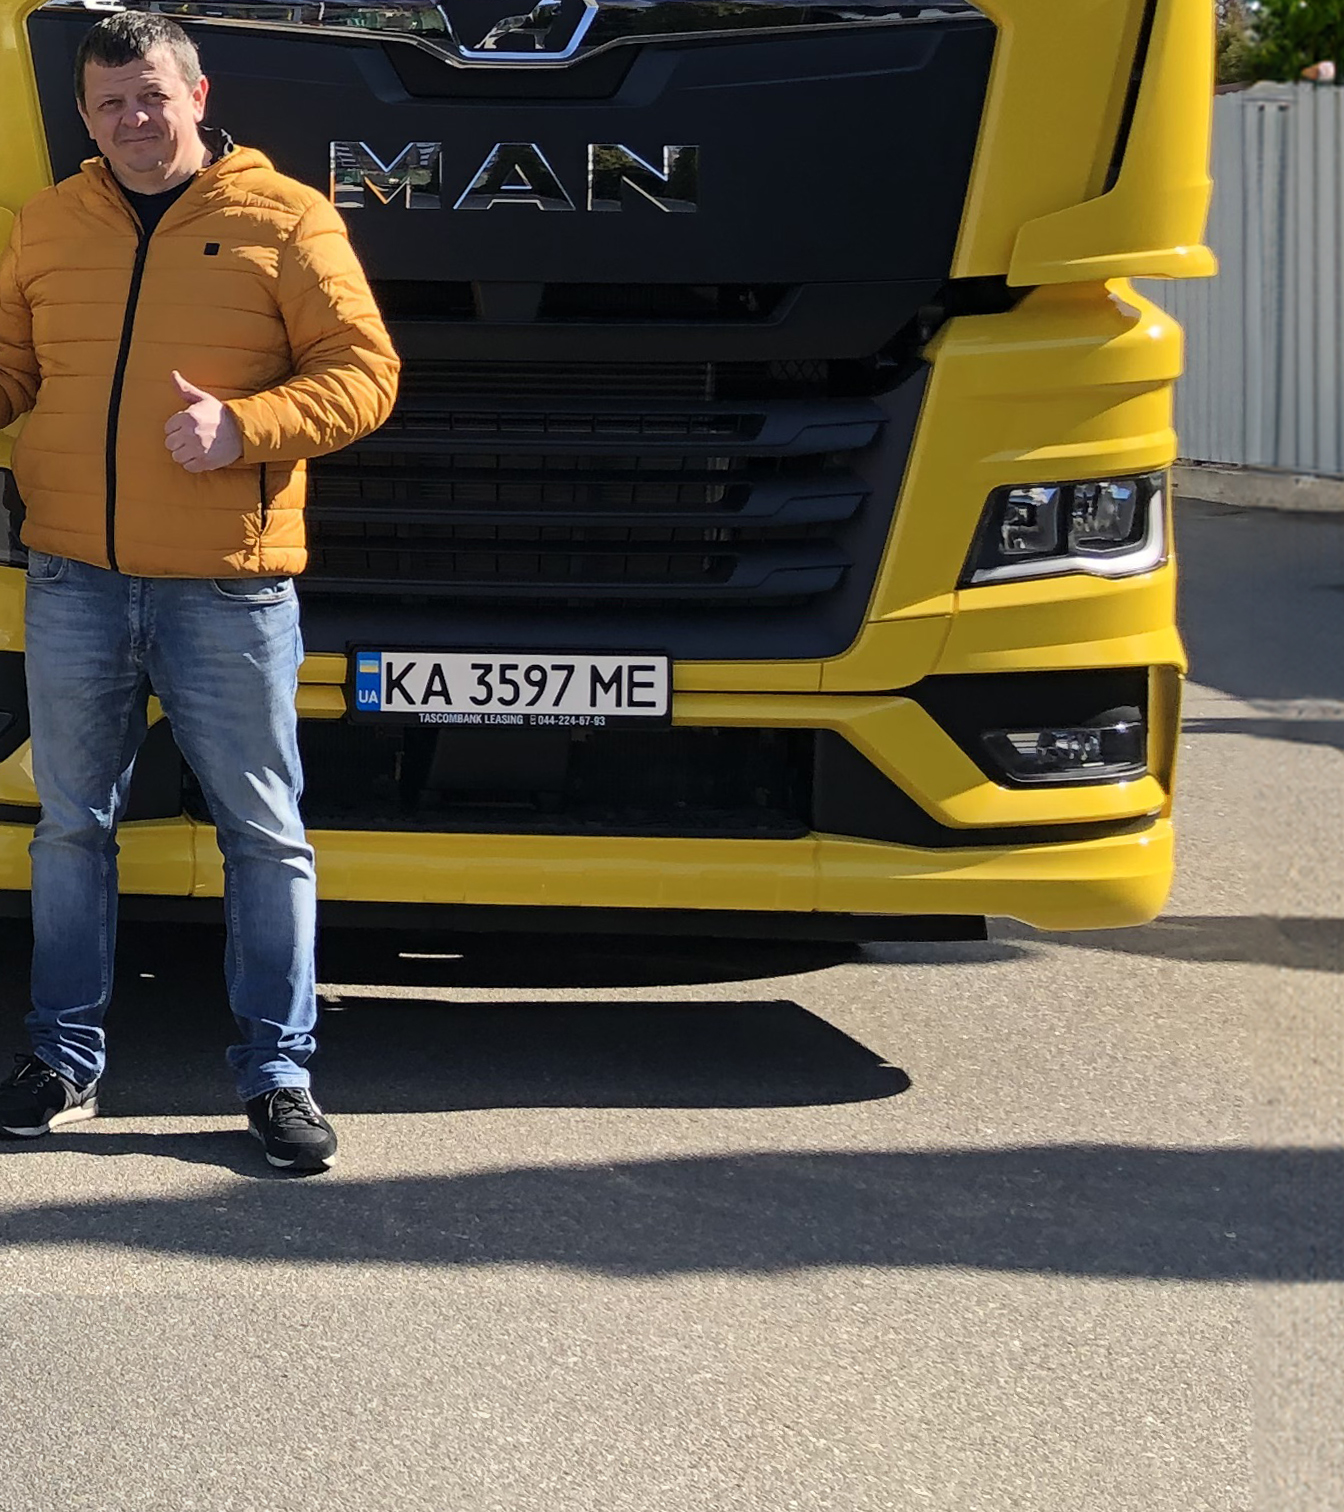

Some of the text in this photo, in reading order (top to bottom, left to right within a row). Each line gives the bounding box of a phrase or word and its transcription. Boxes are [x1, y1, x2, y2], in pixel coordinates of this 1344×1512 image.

[329, 141, 701, 212] MAN
[358, 690, 378, 704] UA
[385, 662, 657, 708] KA 3597 ME
[419, 713, 482, 724] TASCOMBANK
[484, 714, 524, 724] LEASING
